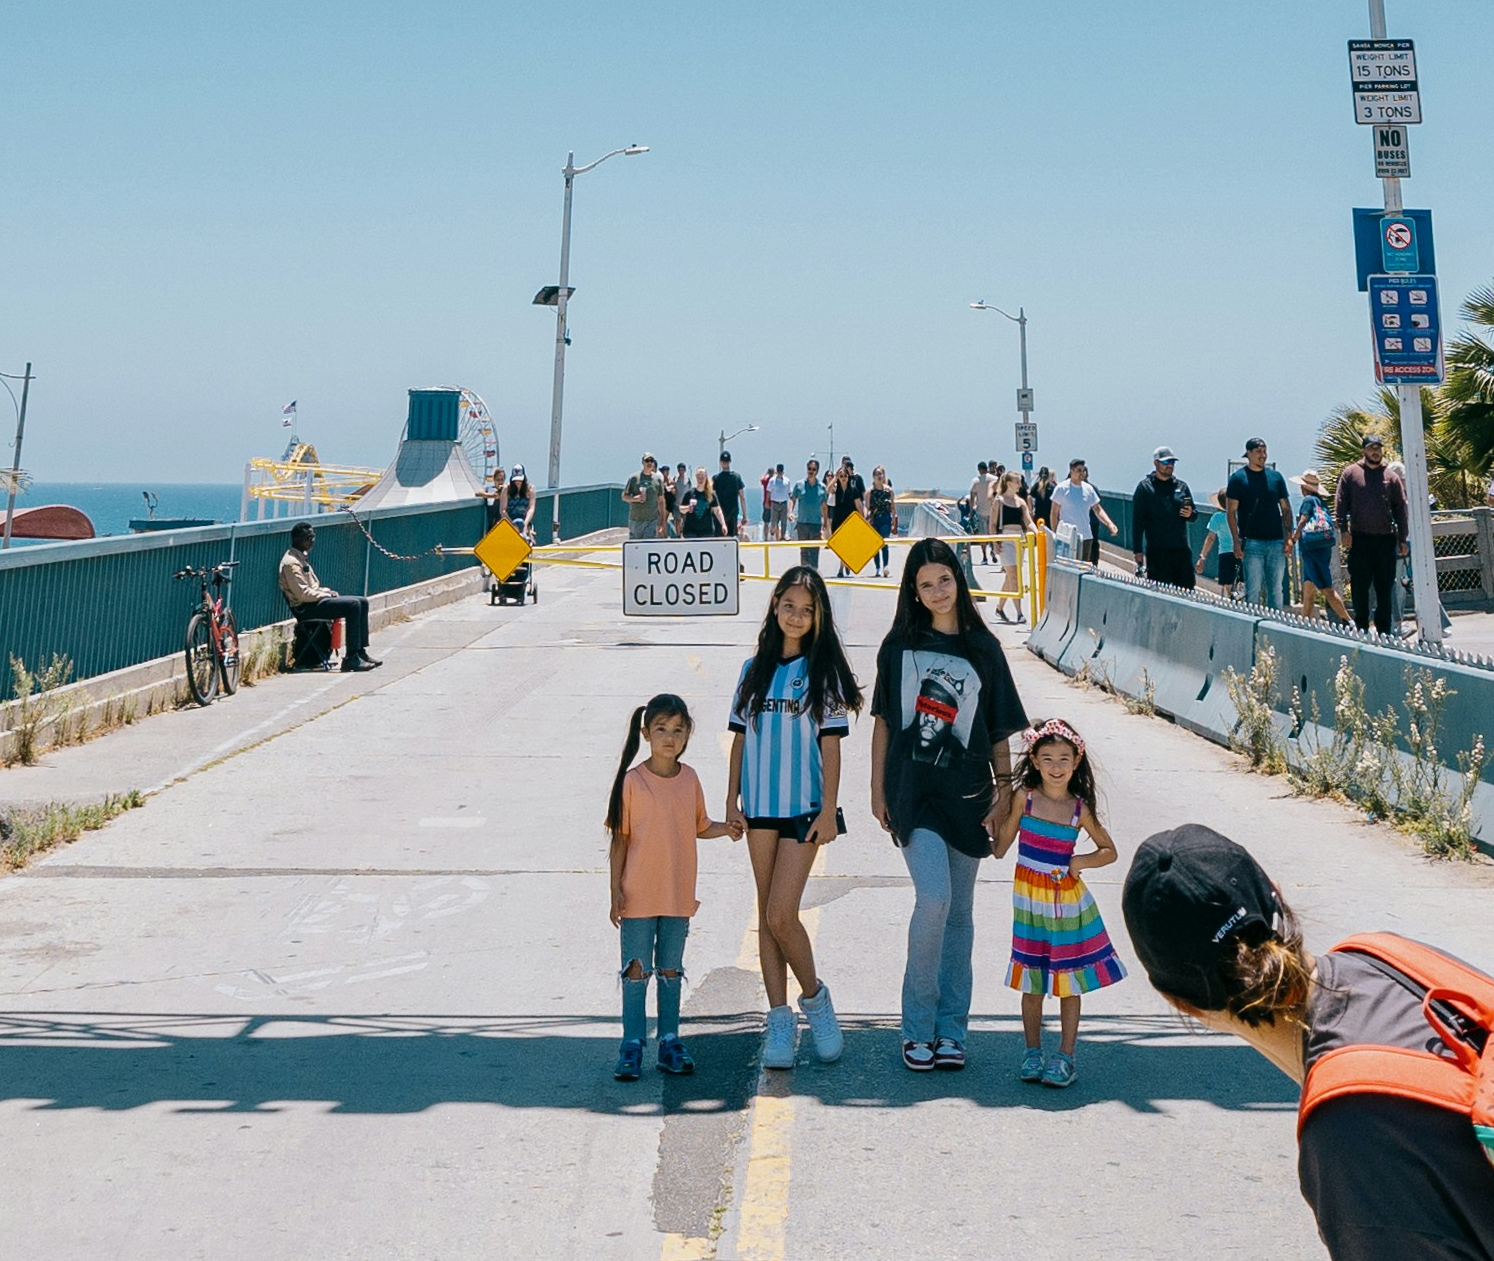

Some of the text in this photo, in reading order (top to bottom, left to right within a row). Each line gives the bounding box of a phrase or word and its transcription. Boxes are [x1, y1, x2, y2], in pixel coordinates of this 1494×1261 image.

[1357, 65, 1410, 77] 15 TONS
[1364, 107, 1412, 118] 3 TONS
[1379, 129, 1401, 147] NO
[1377, 150, 1406, 160] BUSES
[1023, 439, 1031, 449] 5
[647, 551, 714, 574] ROAD
[633, 583, 728, 606] CLOSED
